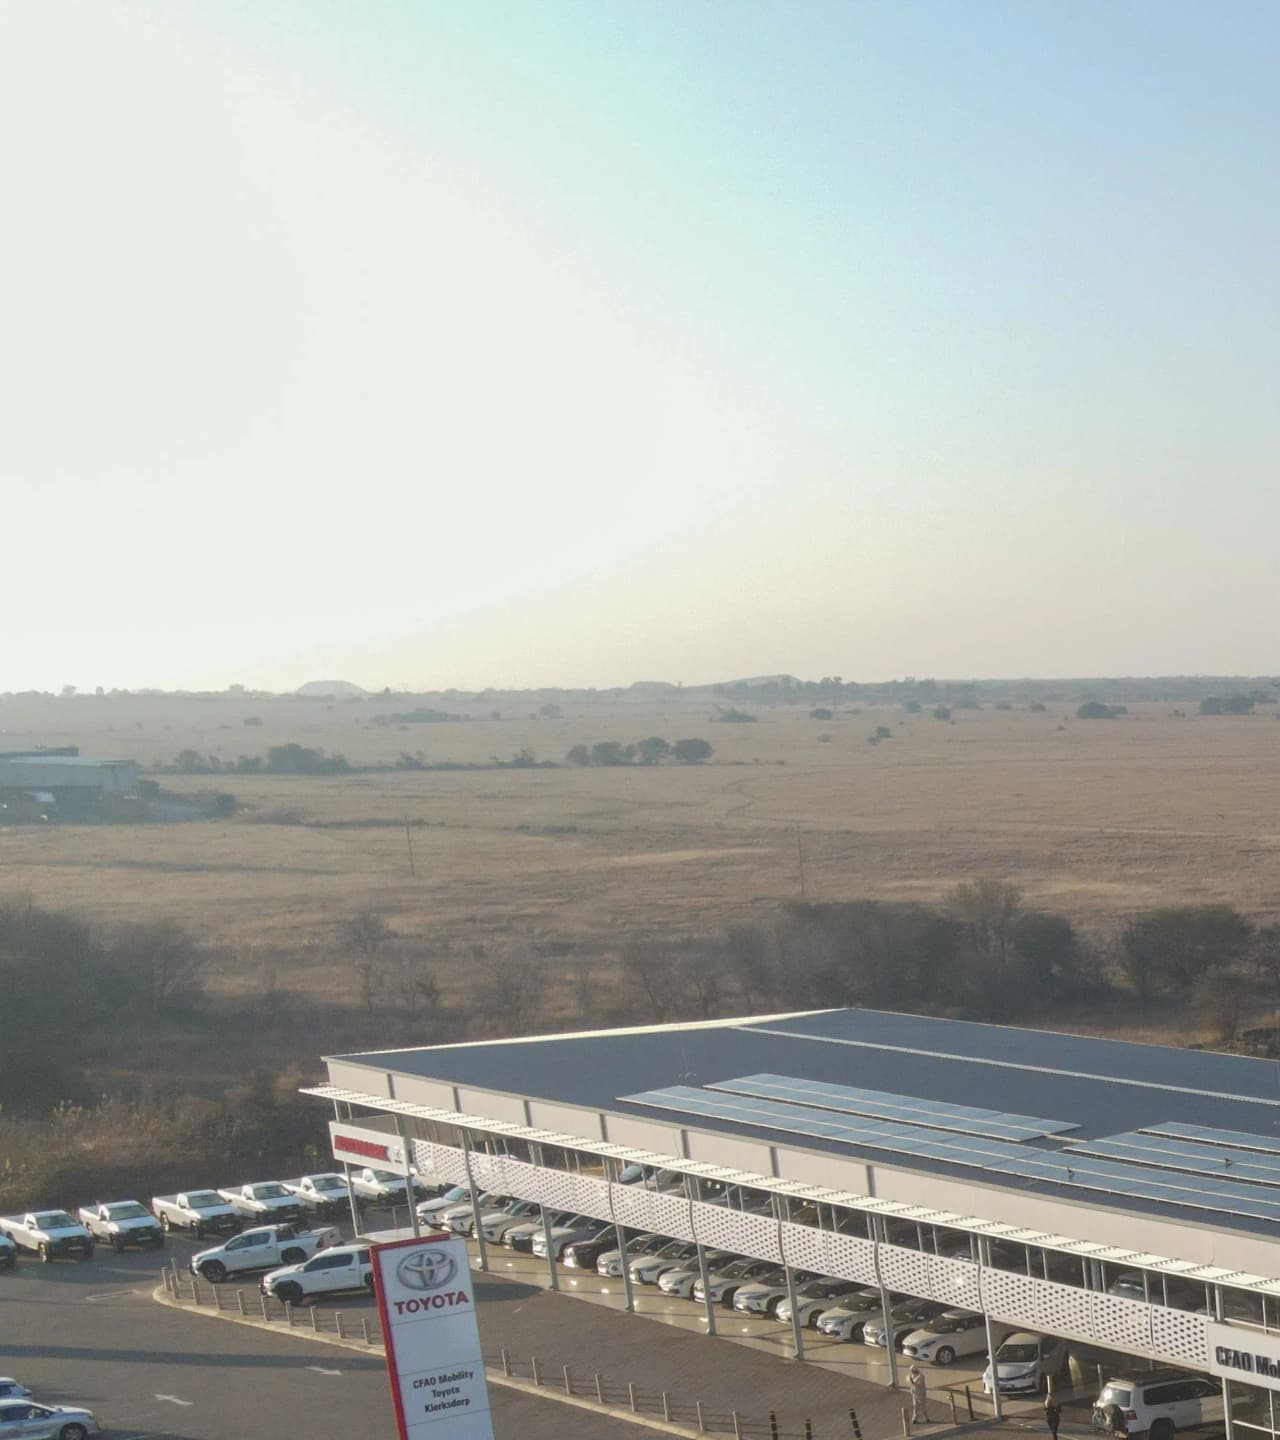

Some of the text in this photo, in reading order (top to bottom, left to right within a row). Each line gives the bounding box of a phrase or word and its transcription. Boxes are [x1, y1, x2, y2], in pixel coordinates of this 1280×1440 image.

[393, 1290, 469, 1315] TOYOTA
[1215, 1345, 1253, 1372] CFAO
[413, 1371, 474, 1389] CFAO Mobility
[431, 1386, 460, 1398] Toyota
